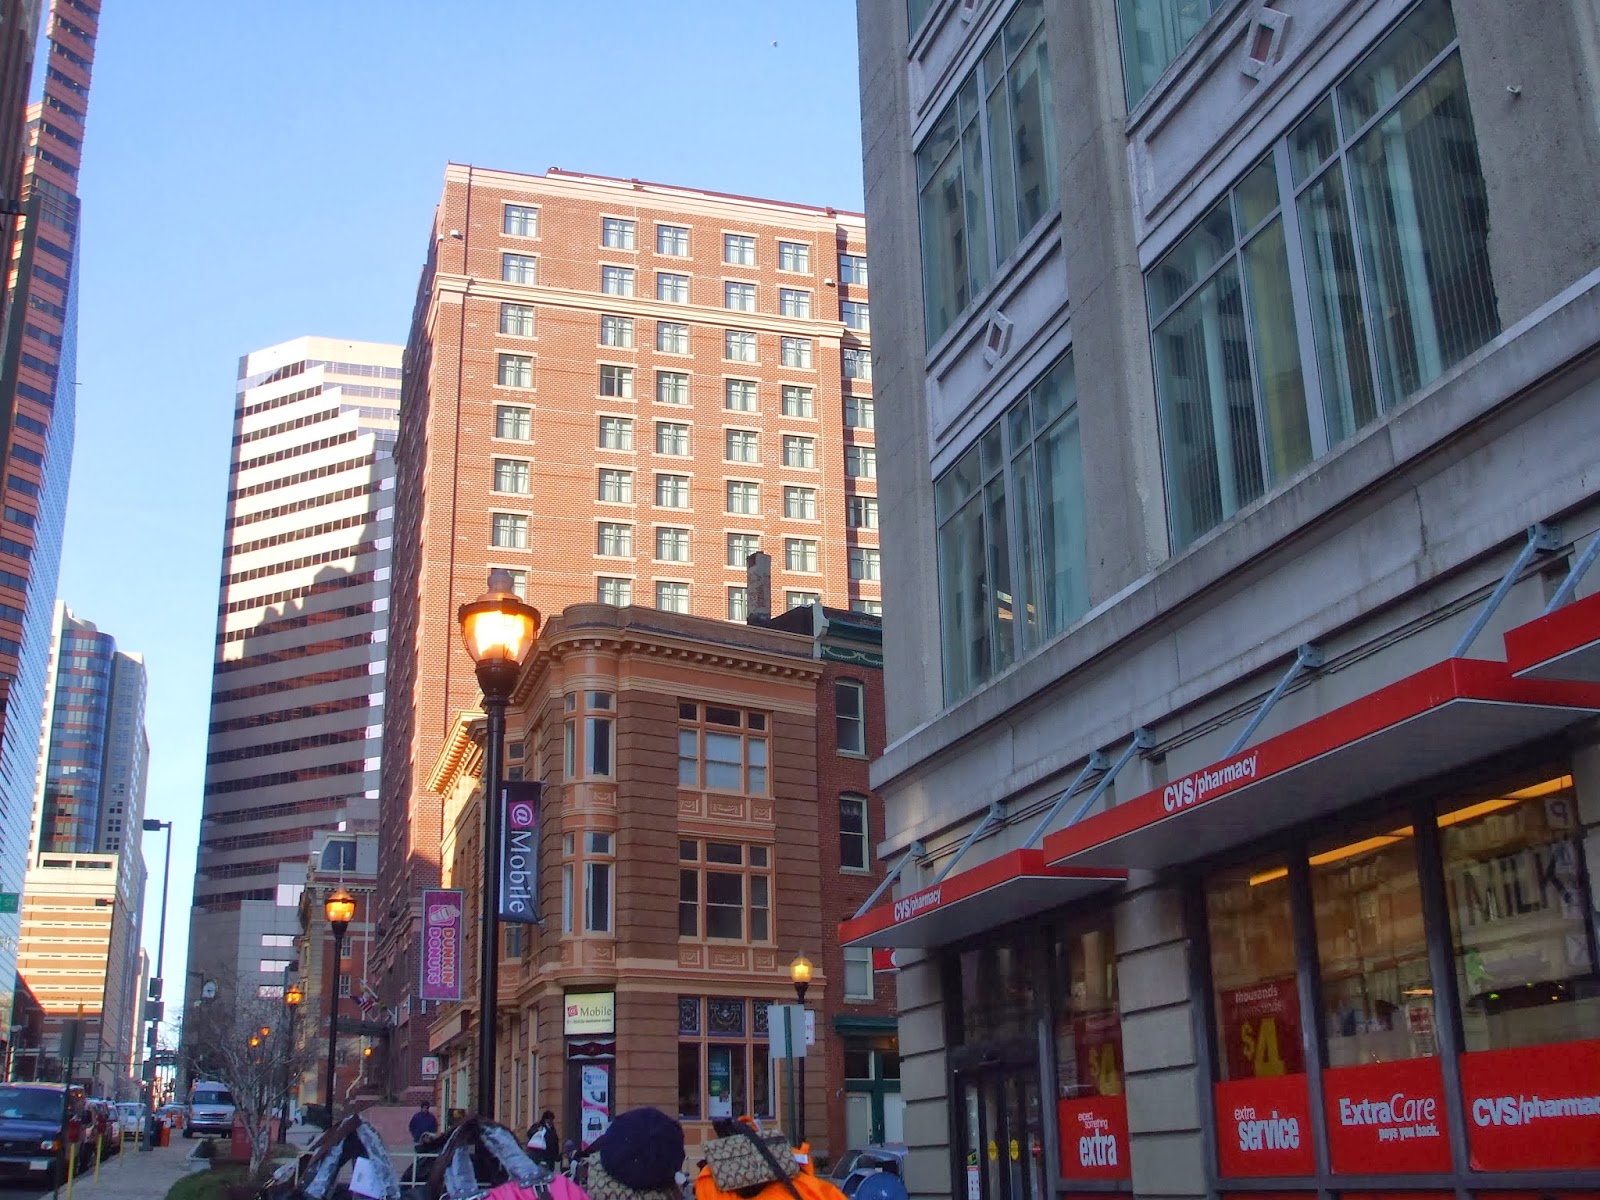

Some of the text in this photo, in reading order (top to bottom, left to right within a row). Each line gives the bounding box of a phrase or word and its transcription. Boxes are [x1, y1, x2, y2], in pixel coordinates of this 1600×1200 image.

[1163, 750, 1258, 812] CVS/pharmacy
[894, 888, 941, 921] CVS/pharmacy
[428, 926, 442, 985] DONUTS
[1235, 984, 1278, 1003] thousands
[1234, 1105, 1256, 1120] extra
[1339, 1093, 1436, 1125] ExtraCare
[1238, 1110, 1299, 1151] service
[1379, 1128, 1398, 1142] pays
[1399, 1126, 1415, 1141] you
[1079, 1129, 1118, 1168] extra
